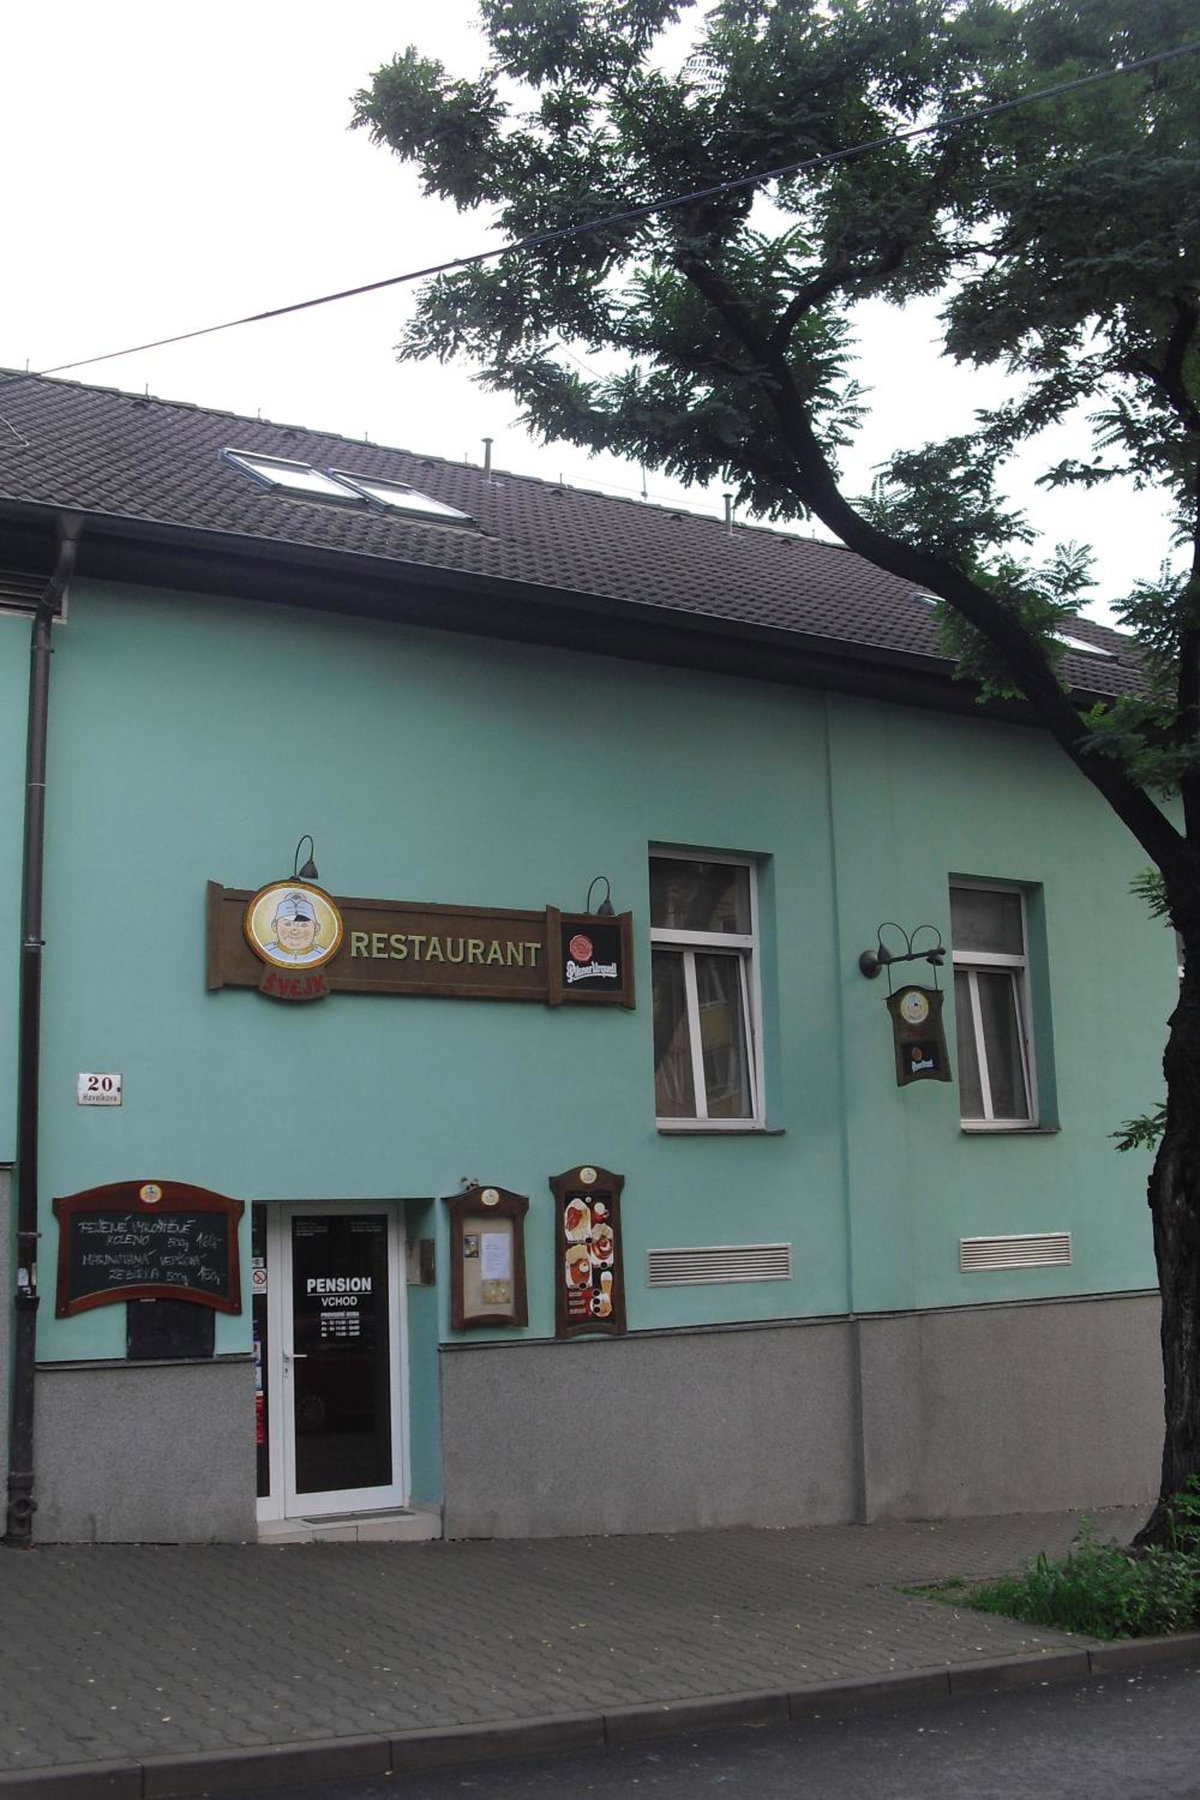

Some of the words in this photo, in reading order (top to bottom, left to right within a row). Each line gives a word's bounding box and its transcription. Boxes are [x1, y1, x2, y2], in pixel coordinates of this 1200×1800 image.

[350, 931, 542, 968] RESTAURANT
[88, 1076, 113, 1092] 20
[307, 1276, 372, 1293] PENSION
[321, 1296, 358, 1307] VCHOD
